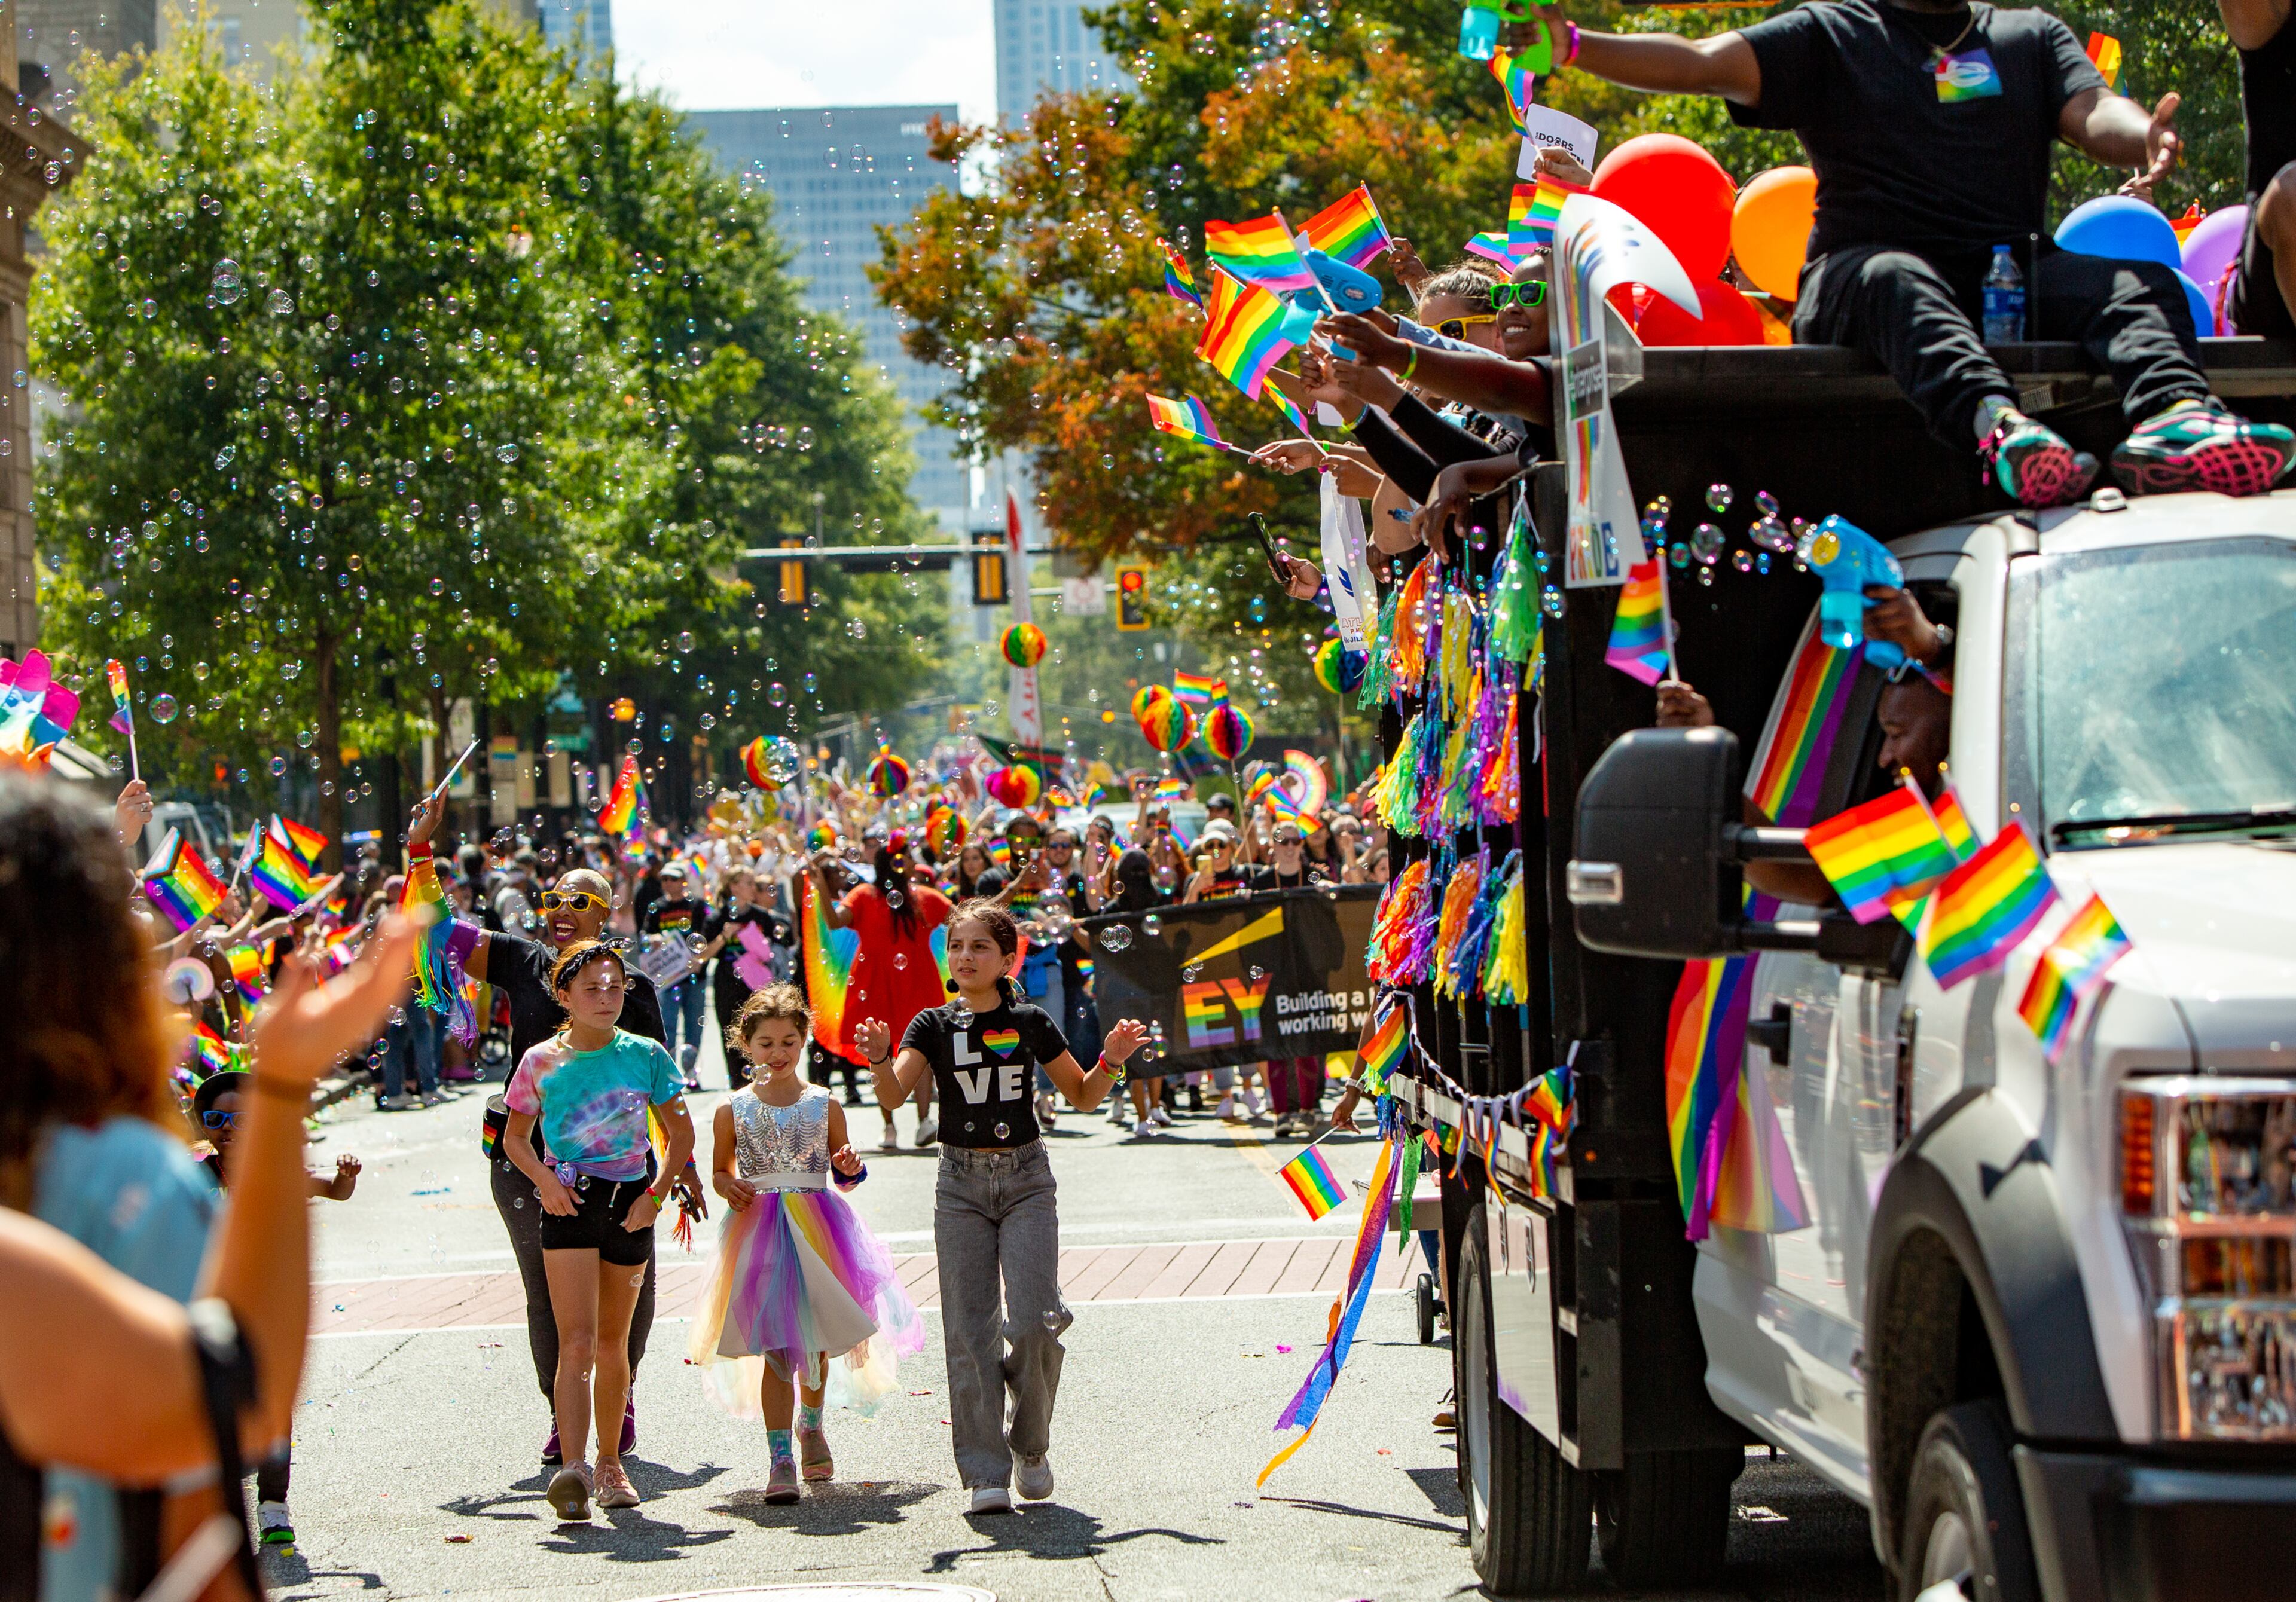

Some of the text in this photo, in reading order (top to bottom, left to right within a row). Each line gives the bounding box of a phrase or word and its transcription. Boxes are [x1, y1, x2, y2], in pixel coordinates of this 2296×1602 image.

[1181, 973, 1274, 1048] EY
[1275, 990, 1348, 1014] Building
[1351, 990, 1365, 1007] a
[1278, 1011, 1348, 1035] working
